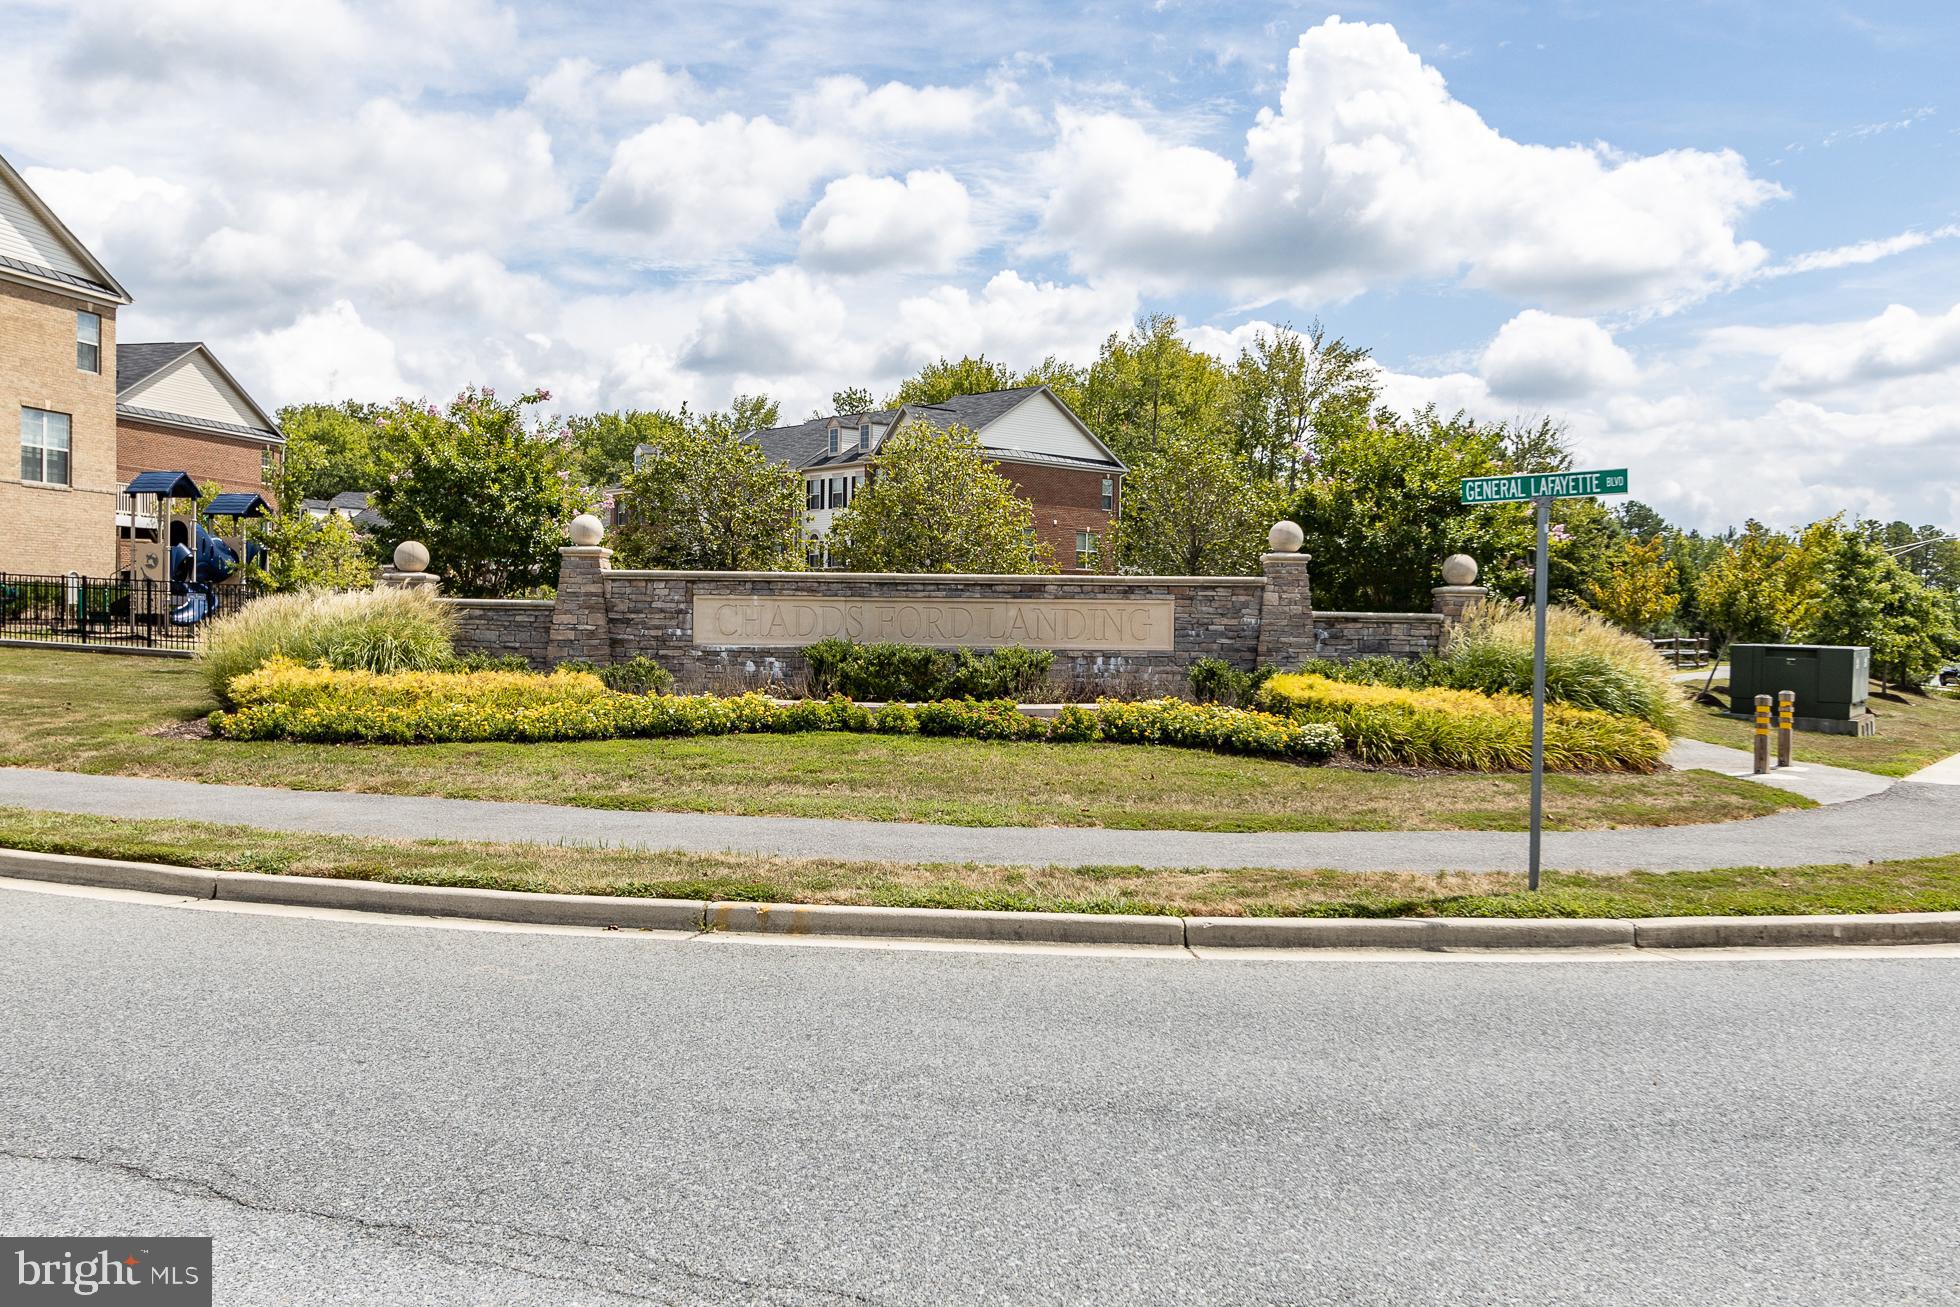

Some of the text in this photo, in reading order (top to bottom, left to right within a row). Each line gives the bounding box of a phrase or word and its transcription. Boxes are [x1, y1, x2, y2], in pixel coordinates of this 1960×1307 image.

[1466, 474, 1624, 501] GENERAL LAFAYETTE BLVD
[715, 603, 1154, 642] CHADDS FORD LANDING
